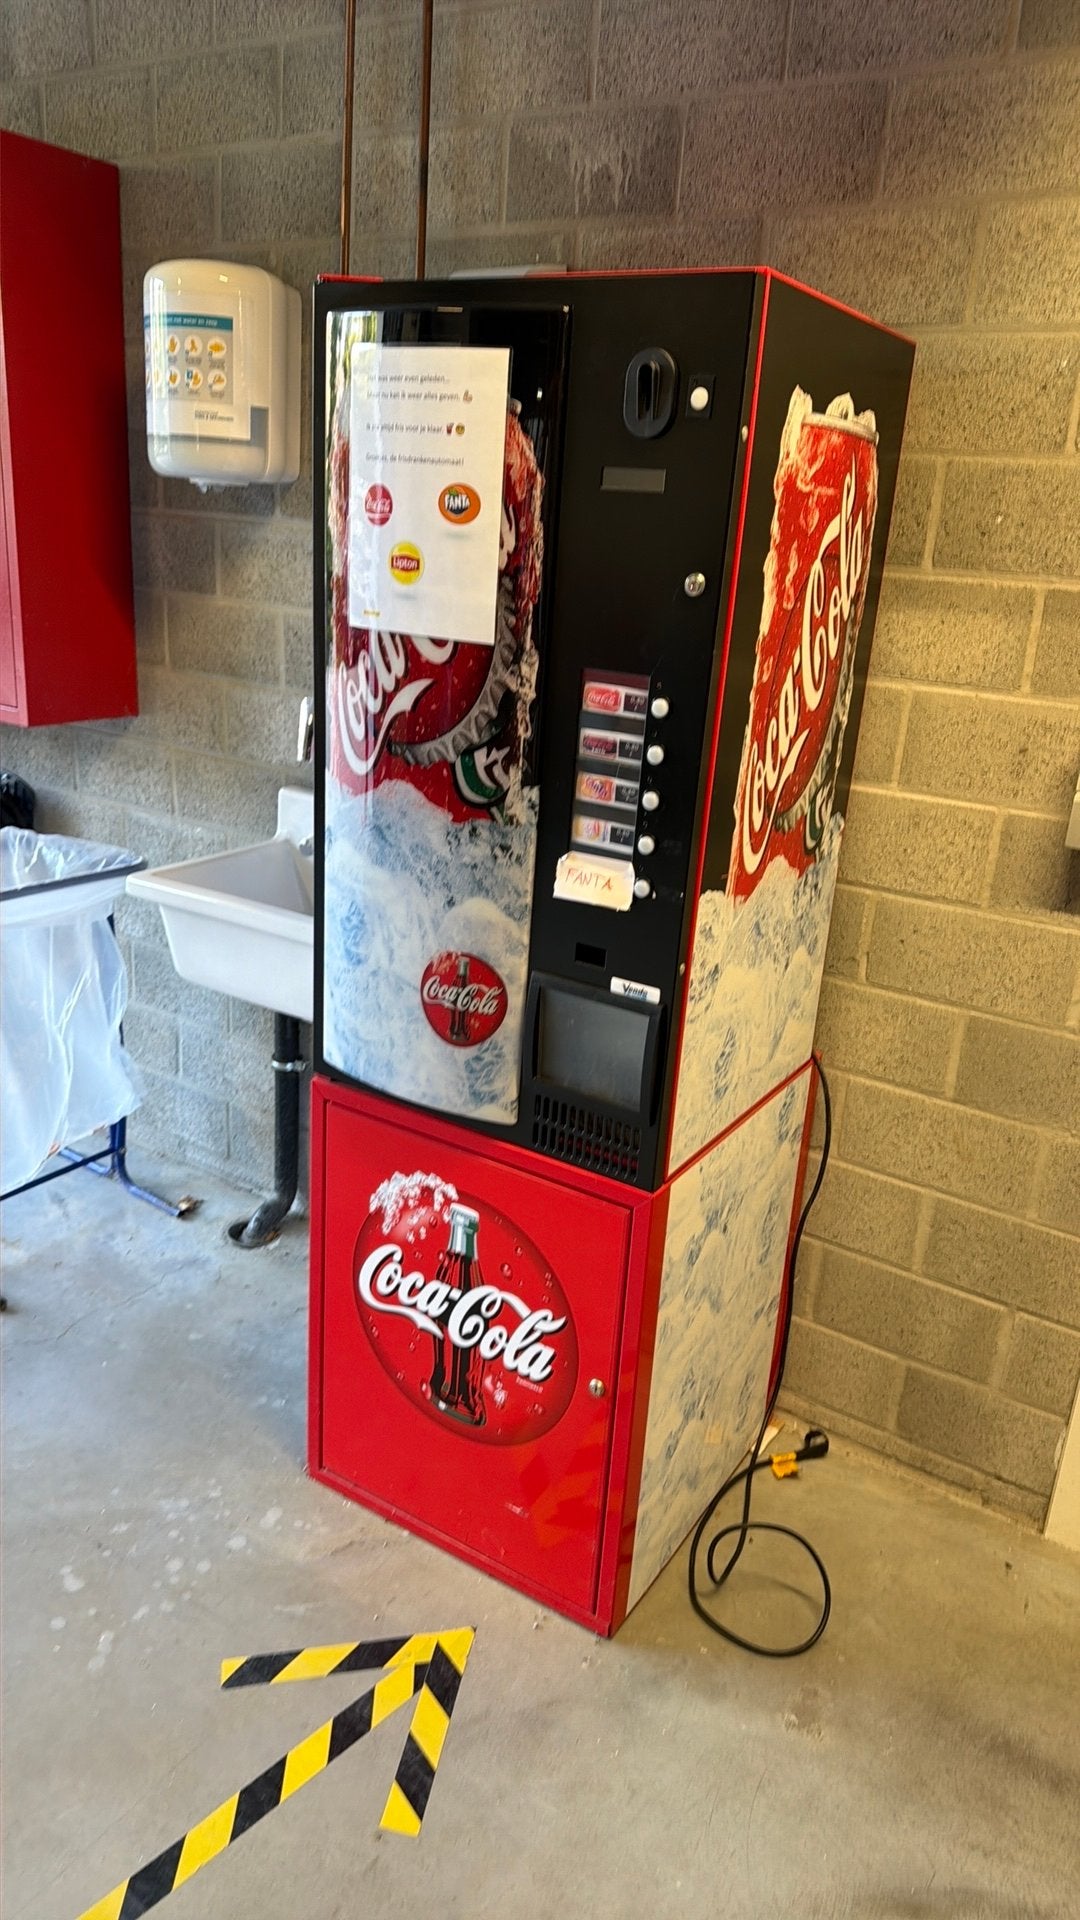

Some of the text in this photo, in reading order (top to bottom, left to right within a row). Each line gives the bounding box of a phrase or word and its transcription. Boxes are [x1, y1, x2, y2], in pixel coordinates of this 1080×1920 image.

[444, 492, 470, 511] FANTA
[392, 556, 418, 570] Lipton
[743, 455, 863, 876] Coca-Cola
[566, 868, 614, 891] FANTA
[422, 975, 504, 1016] Coca-Cola
[358, 1243, 567, 1382] Coca-Cola
